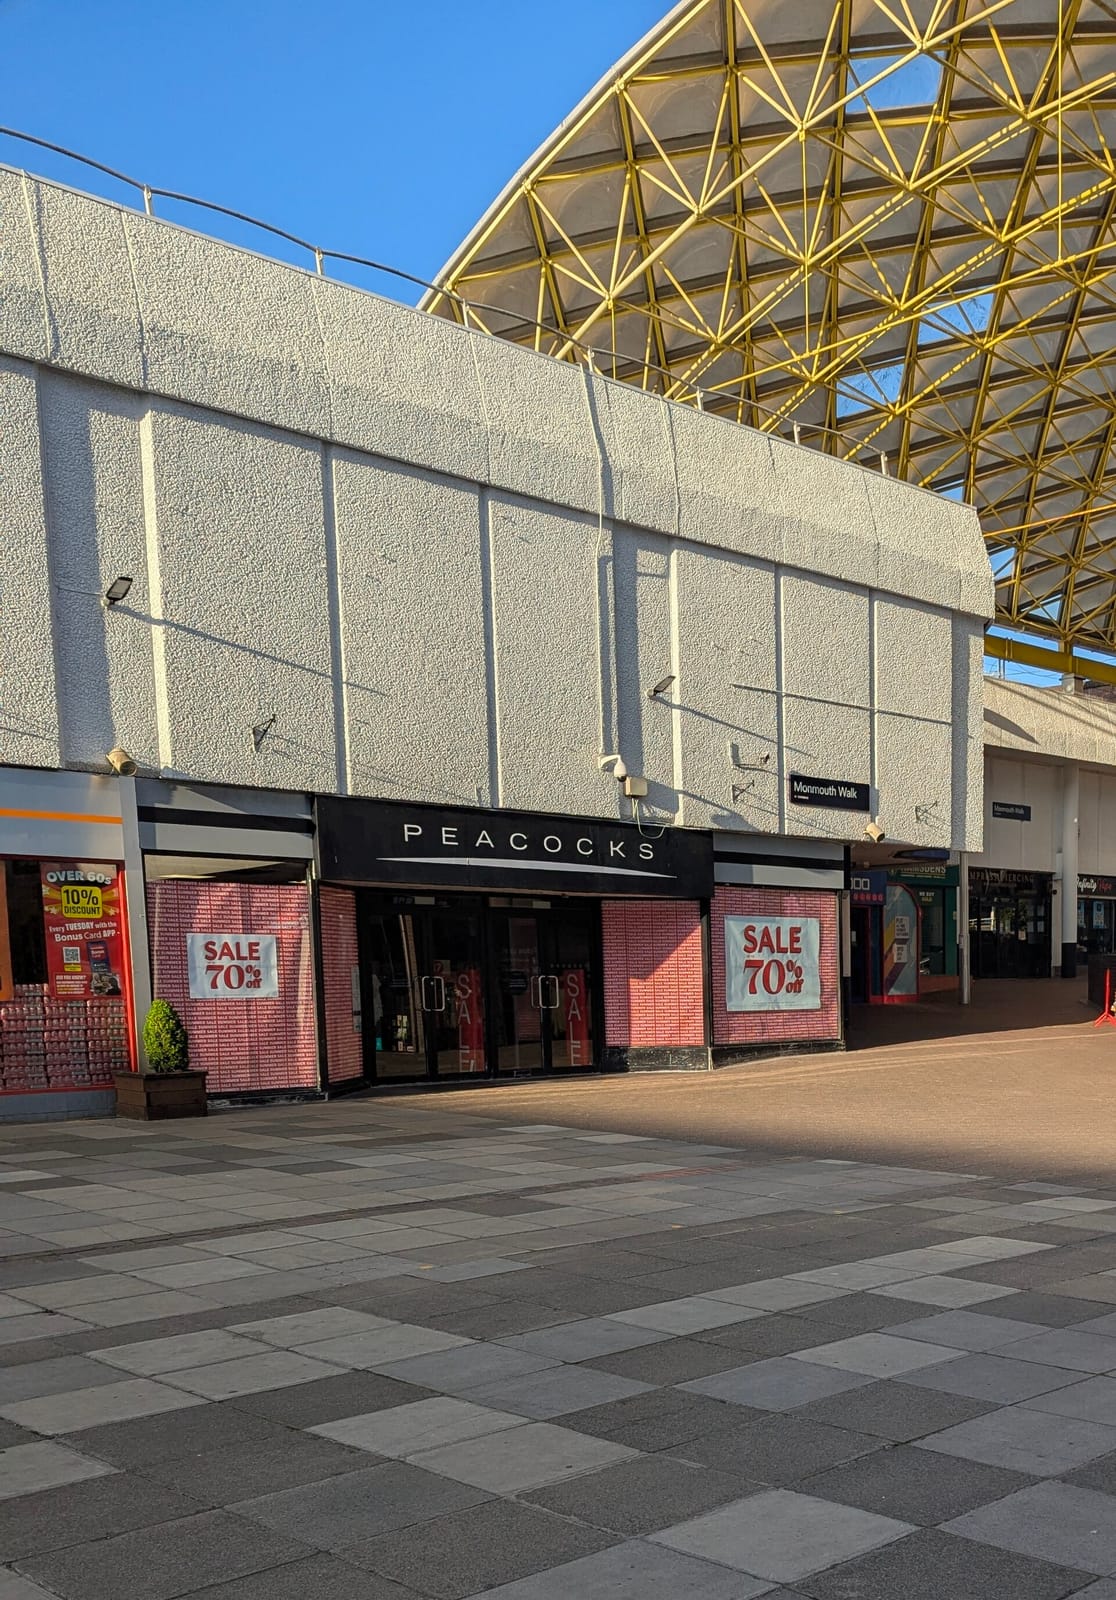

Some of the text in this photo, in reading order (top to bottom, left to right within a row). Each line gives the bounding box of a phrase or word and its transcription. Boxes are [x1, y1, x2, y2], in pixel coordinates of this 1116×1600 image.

[794, 782, 858, 798] Monmouth Walk
[403, 824, 654, 860] PEACOCKS
[46, 870, 112, 885] OVER 60s
[64, 889, 99, 906] 10%
[64, 906, 100, 915] DISCOUNT
[65, 922, 94, 931] TUESDAY
[55, 933, 83, 942] Bonus
[84, 931, 101, 940] Card
[743, 925, 802, 954] SALE
[204, 941, 261, 960] SALE
[205, 964, 261, 989] 70%
[246, 978, 262, 988] off
[743, 959, 803, 995] 70%
[785, 978, 804, 993] off
